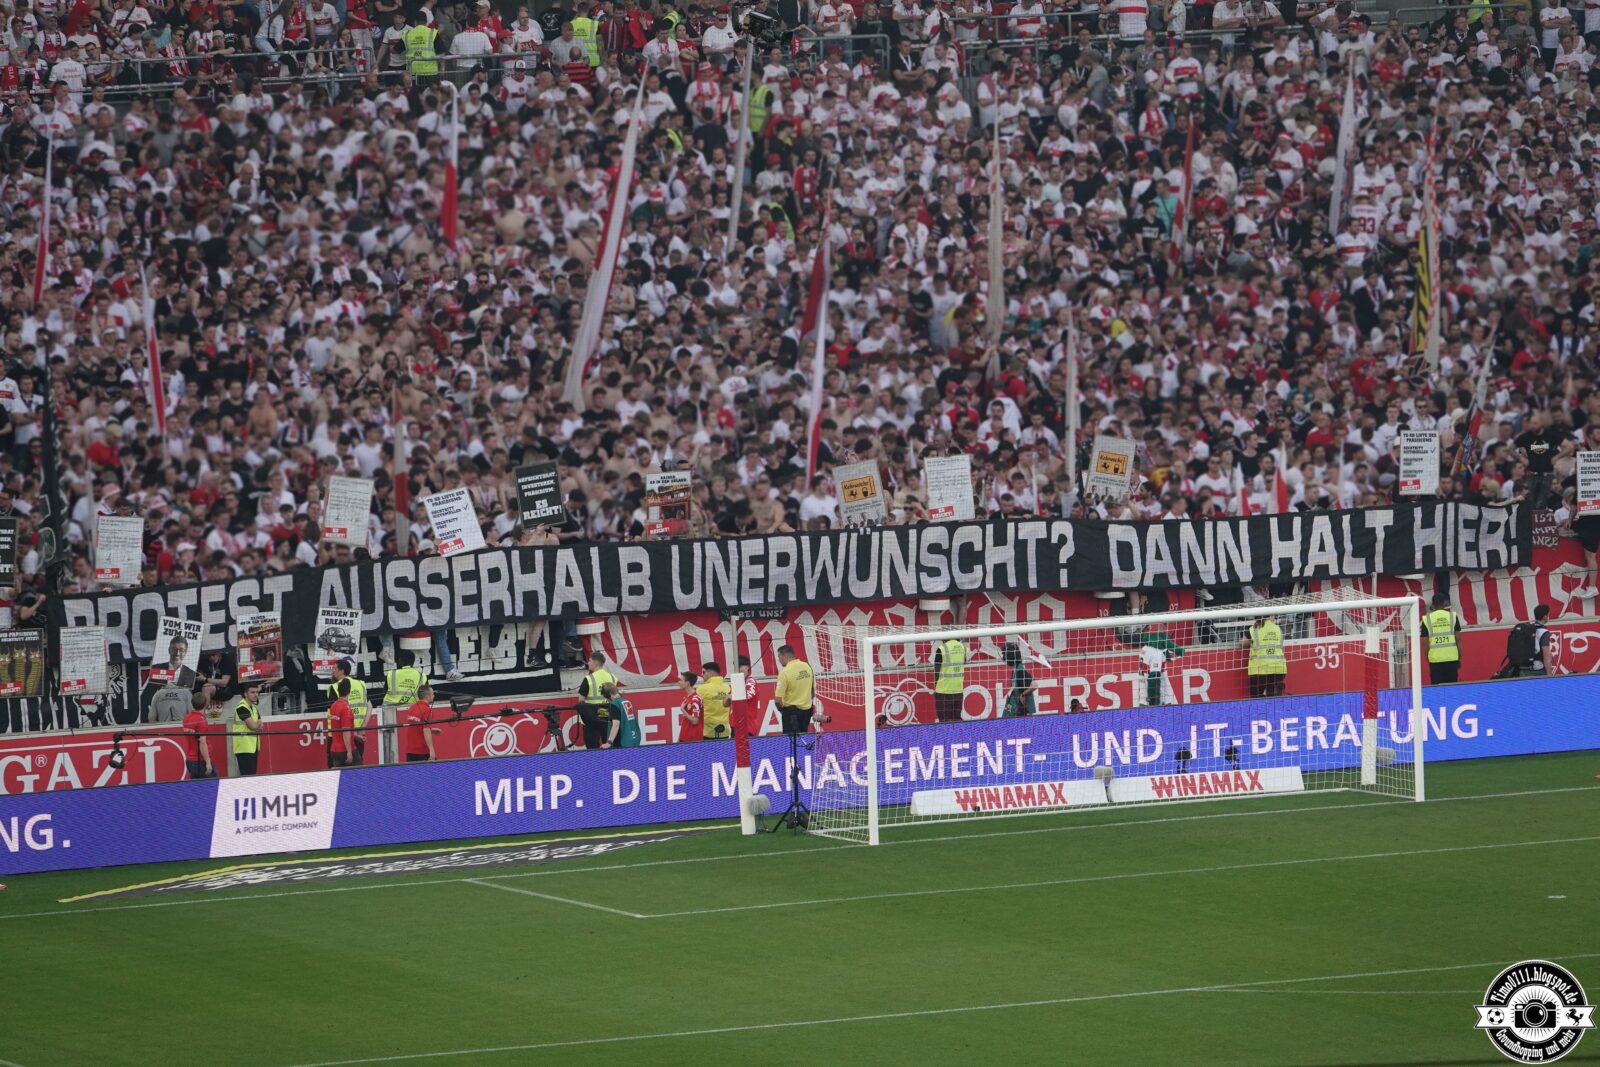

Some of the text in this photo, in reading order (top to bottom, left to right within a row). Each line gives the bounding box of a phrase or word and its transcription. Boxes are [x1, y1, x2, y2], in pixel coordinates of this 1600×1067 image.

[535, 499, 548, 509] ES
[522, 505, 562, 520] REICHT!
[63, 574, 294, 661] PROTEST
[318, 546, 653, 631] AUSSERHALB
[671, 520, 1076, 610] UNERWÜNSCHT?
[1106, 519, 1252, 588] DANN
[1269, 508, 1394, 577] HALT
[1413, 502, 1519, 570] HIER!
[321, 609, 348, 618] DRIVEN
[738, 610, 755, 618] BEI
[163, 619, 201, 632] VOM WIR
[325, 618, 354, 626] DREAMS
[163, 628, 182, 637] ZUM
[1435, 636, 1450, 644] 2371
[1314, 644, 1341, 670] 35
[299, 721, 327, 747] 34
[475, 773, 584, 816] MHP.
[612, 764, 687, 805] DIE
[711, 737, 1047, 797] MANAGEMENT-
[1072, 729, 1164, 769] UND
[1150, 769, 1265, 799] WINAMAX
[954, 783, 1068, 812] WINAMAX
[262, 793, 318, 818] MHP
[235, 821, 319, 835] A PORSCHE COMPANY
